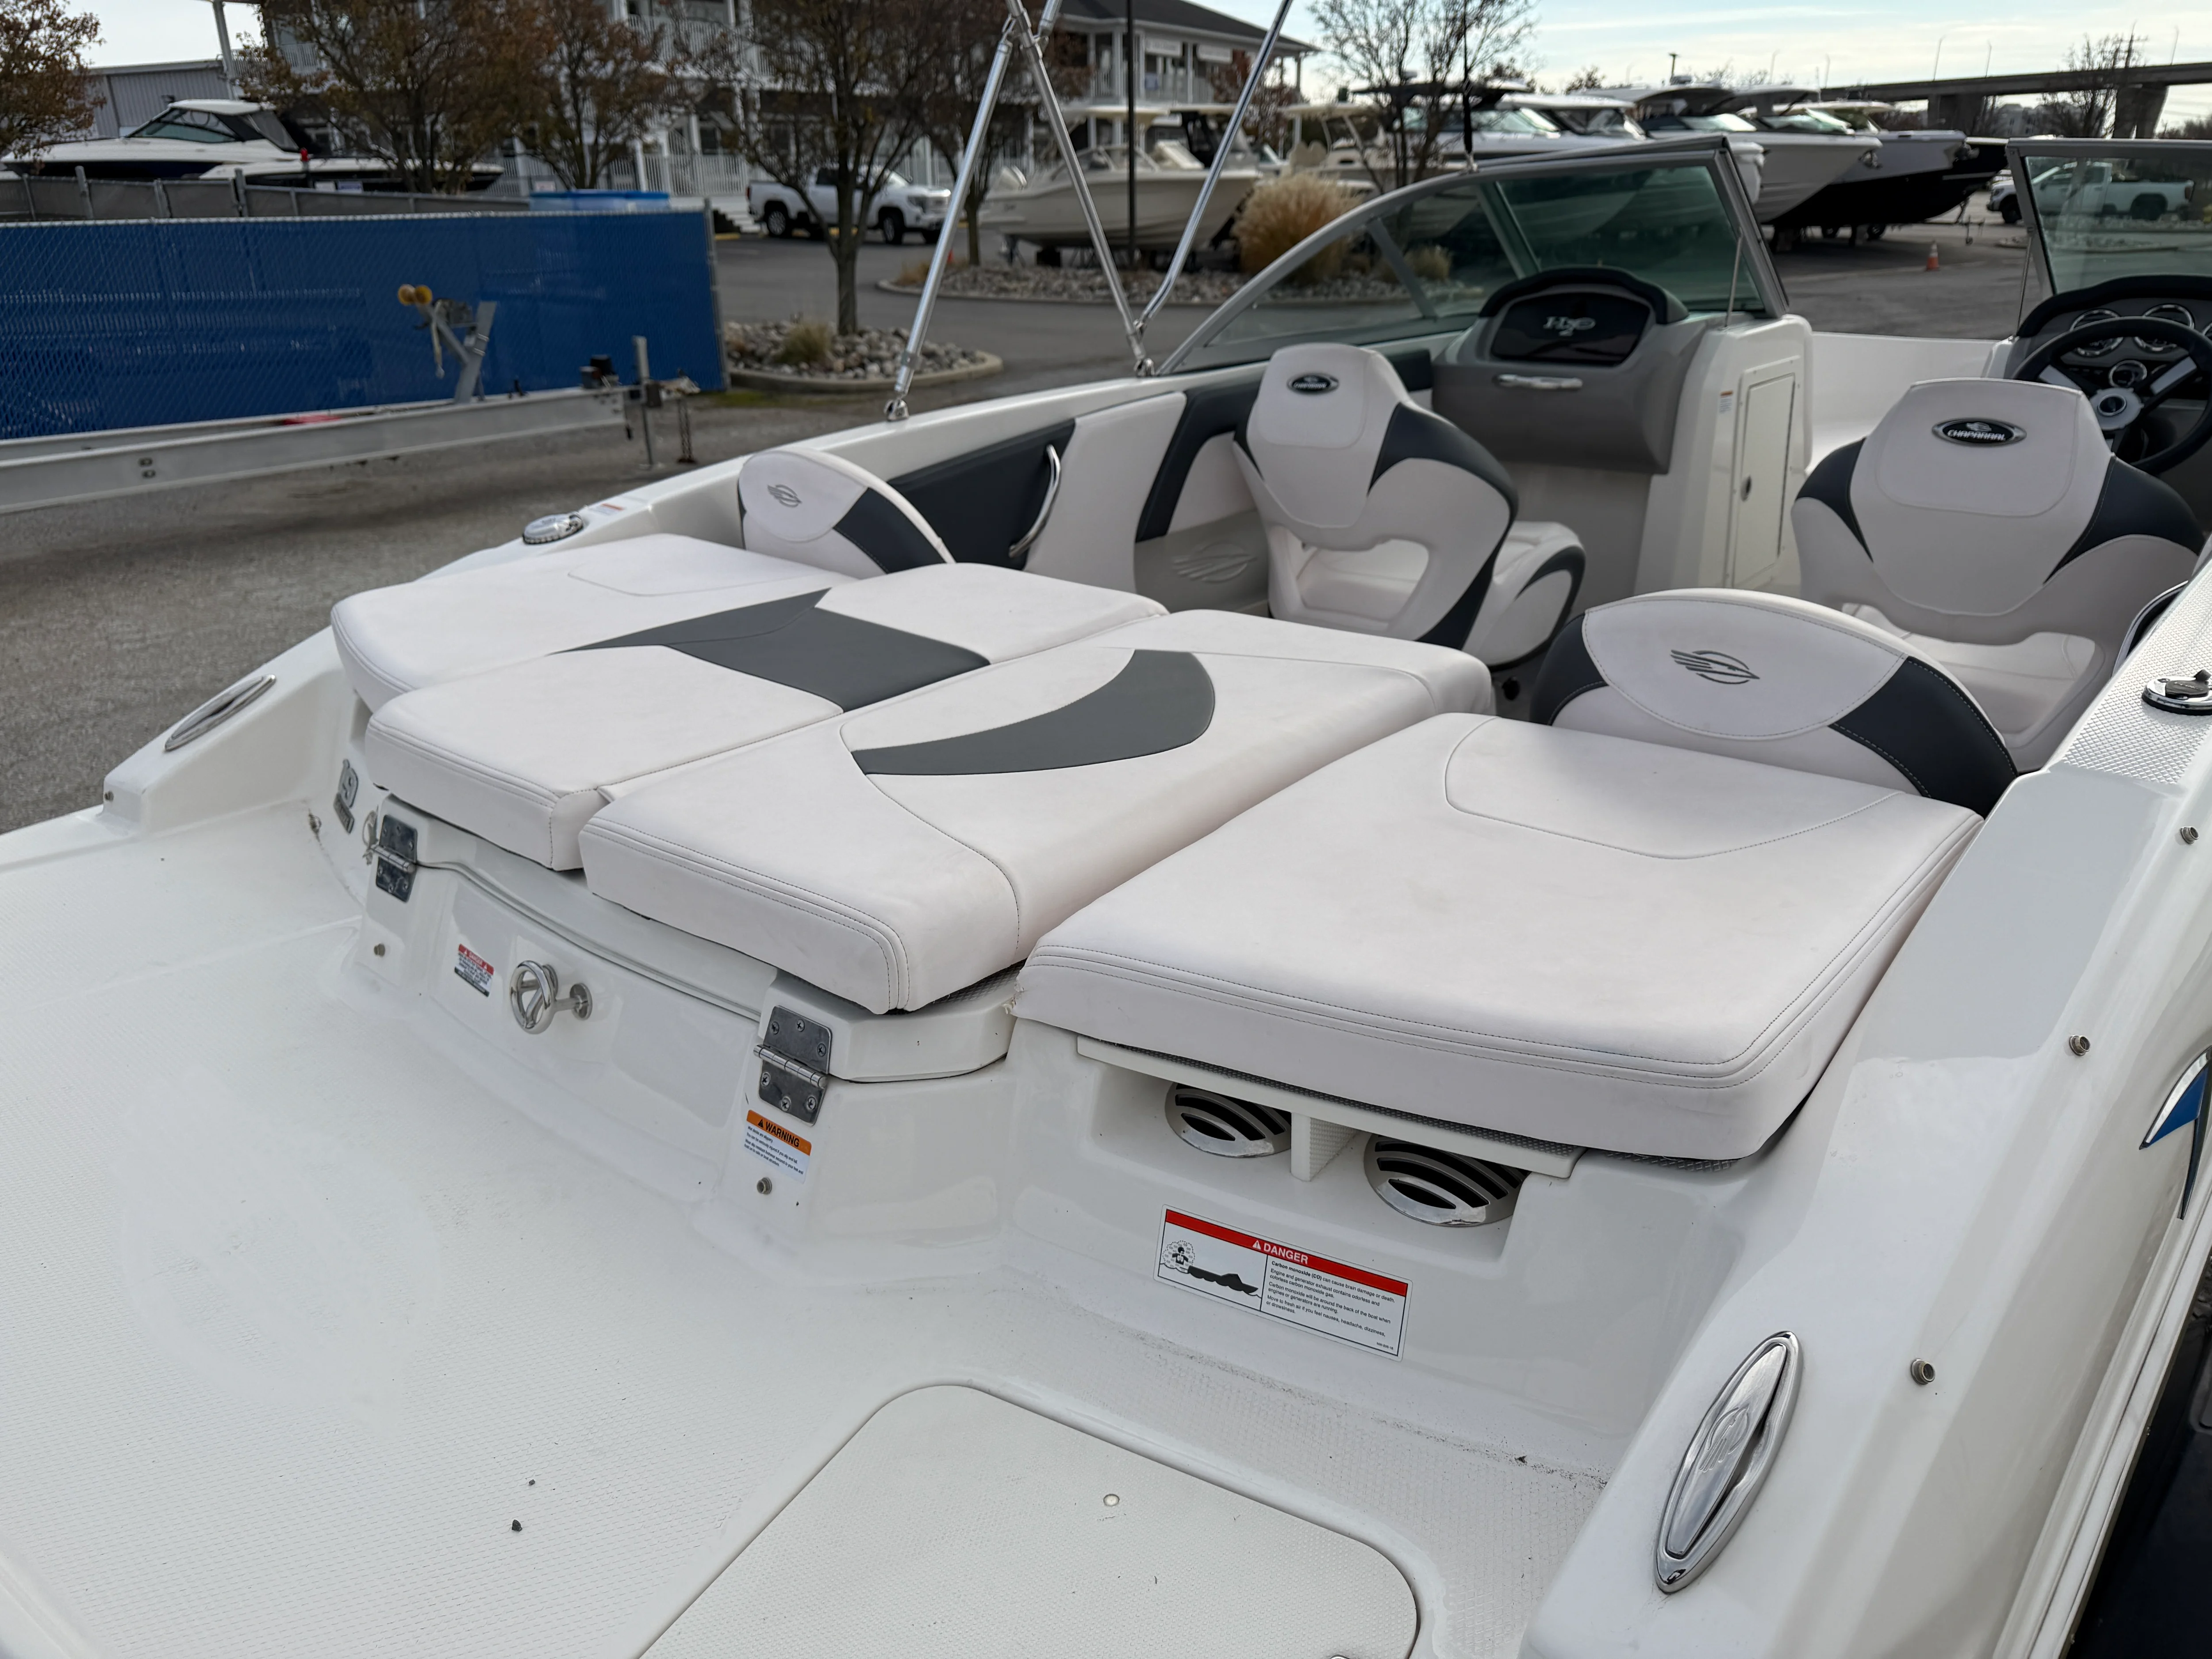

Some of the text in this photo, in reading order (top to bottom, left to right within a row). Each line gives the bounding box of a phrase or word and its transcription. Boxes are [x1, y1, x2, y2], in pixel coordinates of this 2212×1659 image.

[766, 1121, 799, 1147] WARNING
[1263, 1243, 1308, 1264] DANGER
[1269, 1282, 1284, 1290] Carbon
[1272, 1261, 1288, 1269] Carbon
[1357, 1288, 1375, 1297] damage
[1294, 1277, 1315, 1286] generator
[1352, 1295, 1370, 1303] odorless
[1290, 1295, 1313, 1305] generators
[1323, 1314, 1340, 1322] nausea,
[1341, 1319, 1363, 1330] headache,
[1364, 1326, 1385, 1337] dizziness,
